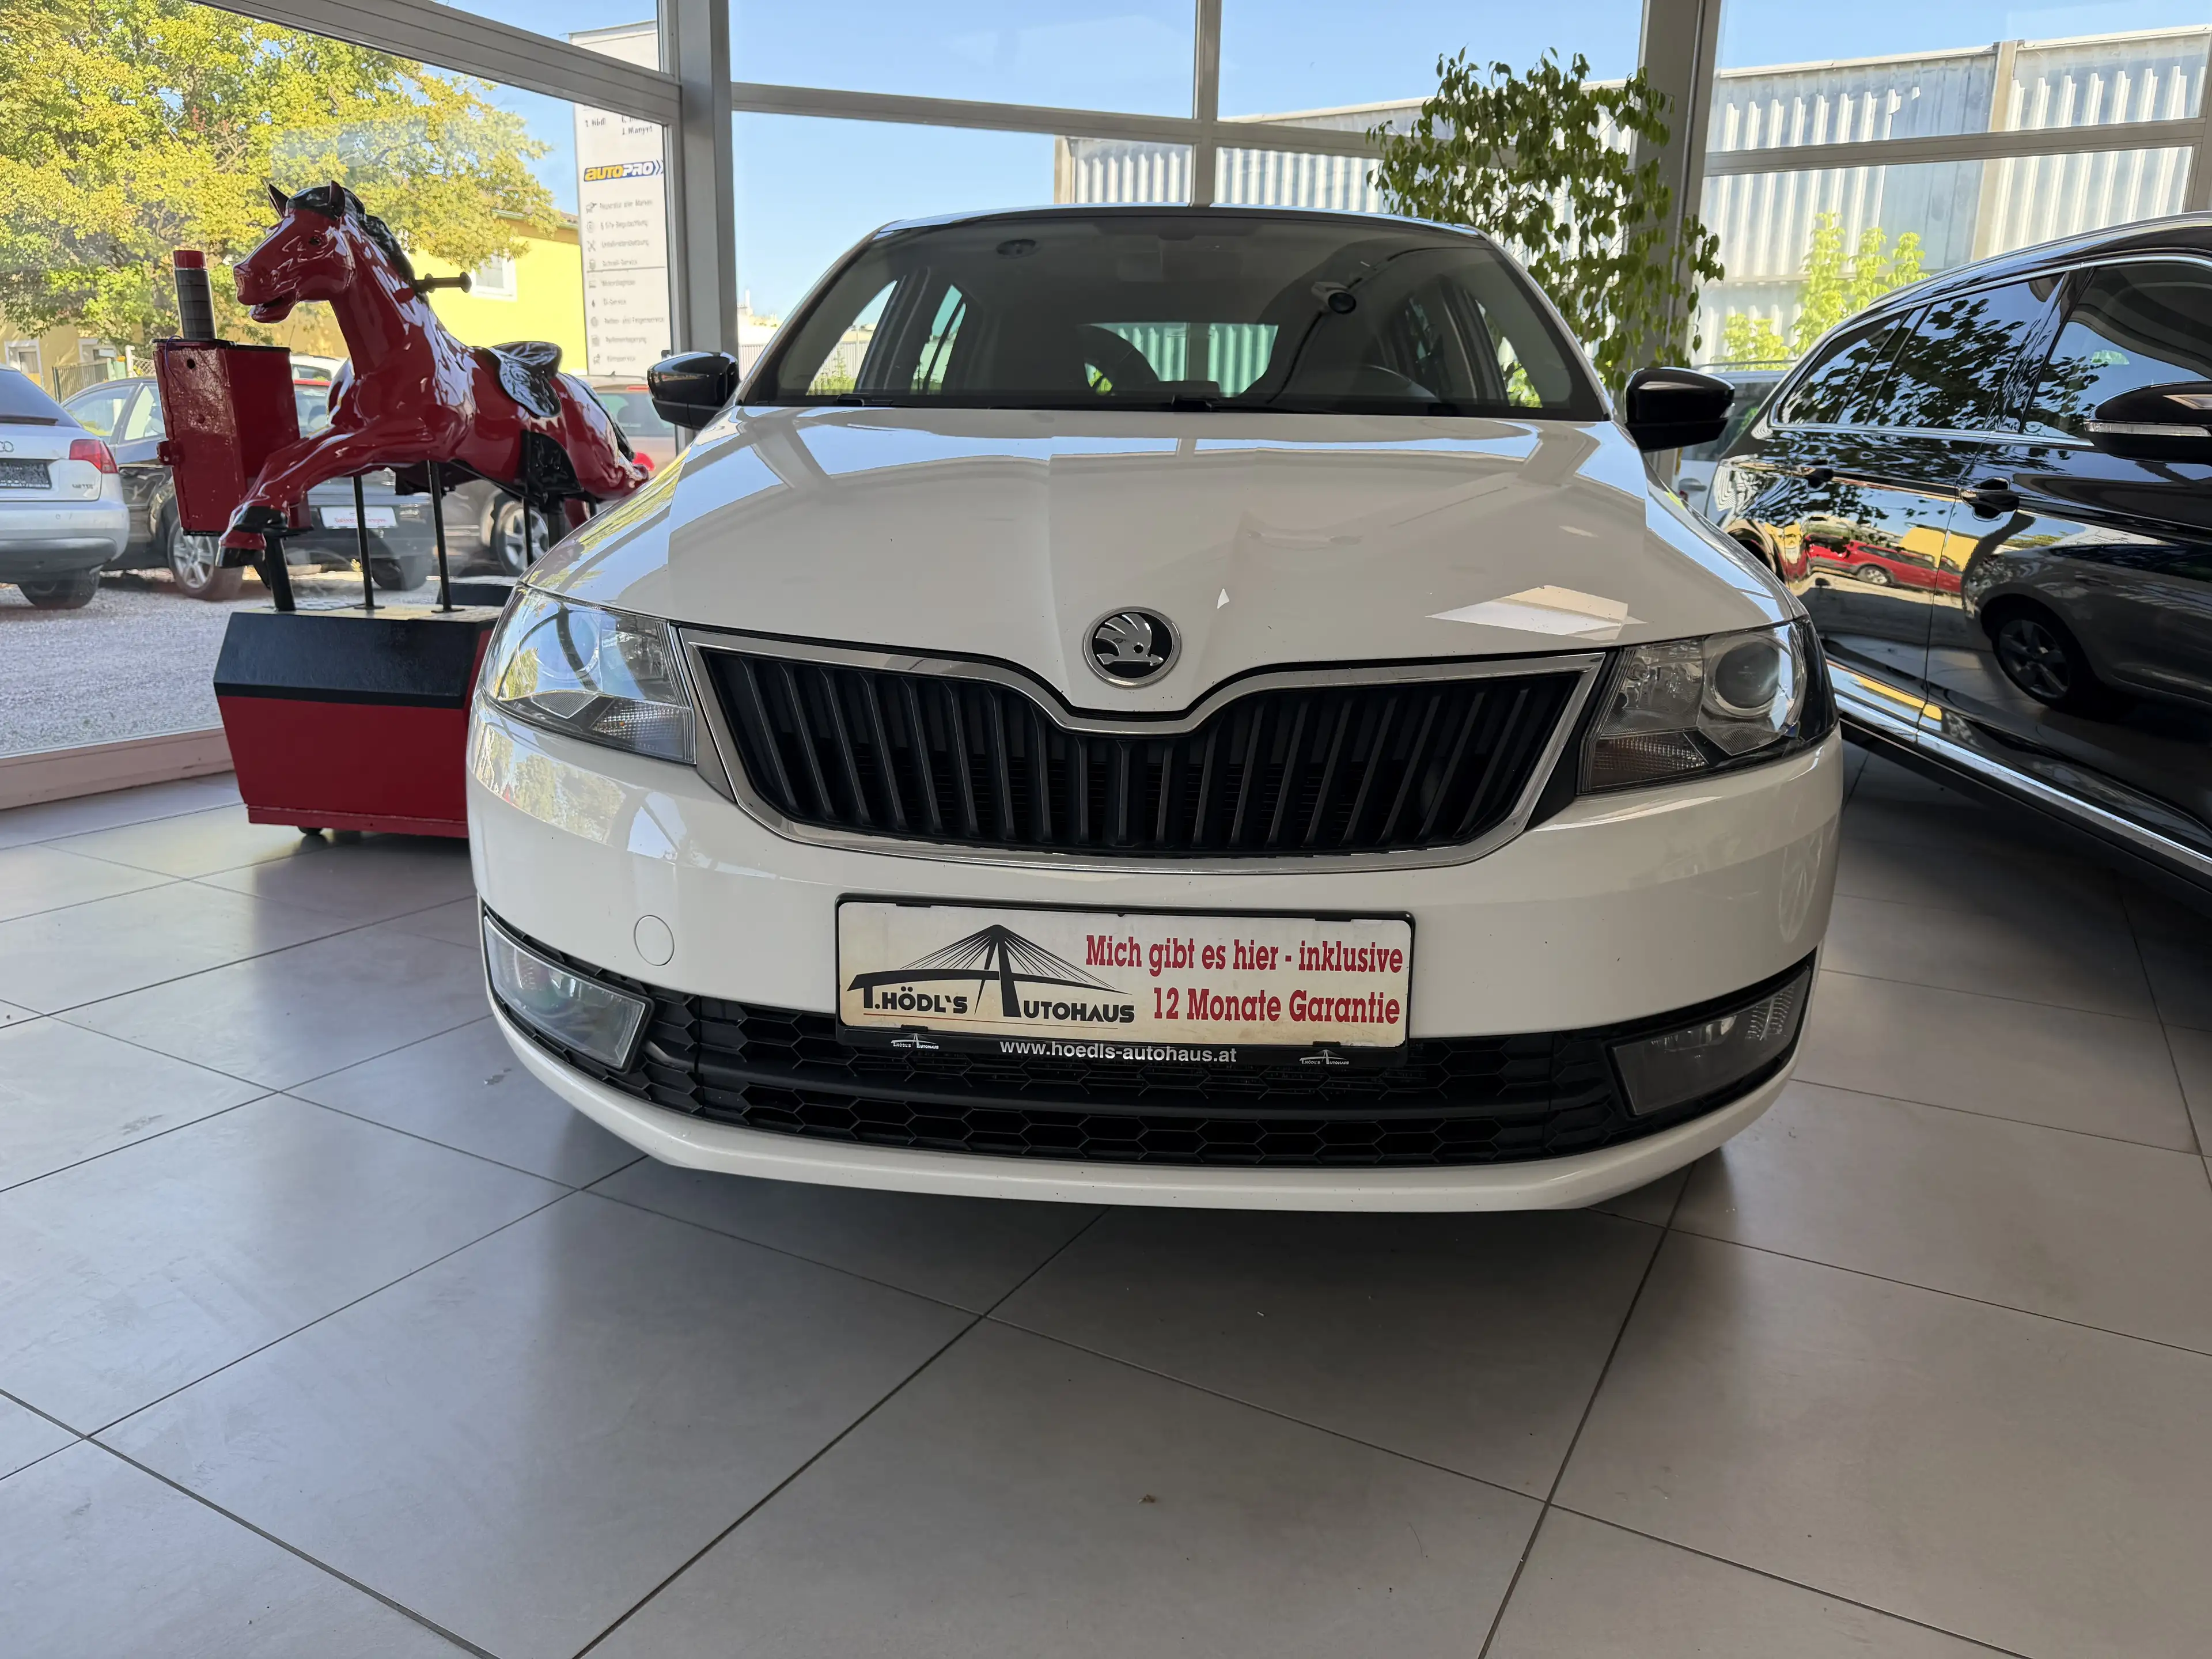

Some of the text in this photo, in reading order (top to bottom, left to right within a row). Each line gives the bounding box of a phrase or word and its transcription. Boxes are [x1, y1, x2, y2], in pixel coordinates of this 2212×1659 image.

[1086, 935, 1142, 967] Mich
[1149, 938, 1195, 976] gibt
[1202, 945, 1226, 969] es
[1233, 940, 1279, 971] hier
[1298, 940, 1403, 973] inklusive
[1154, 987, 1400, 1024] 12 Monate Garantie
[1000, 1041, 1237, 1062] www.hoedls-autohaus.at
